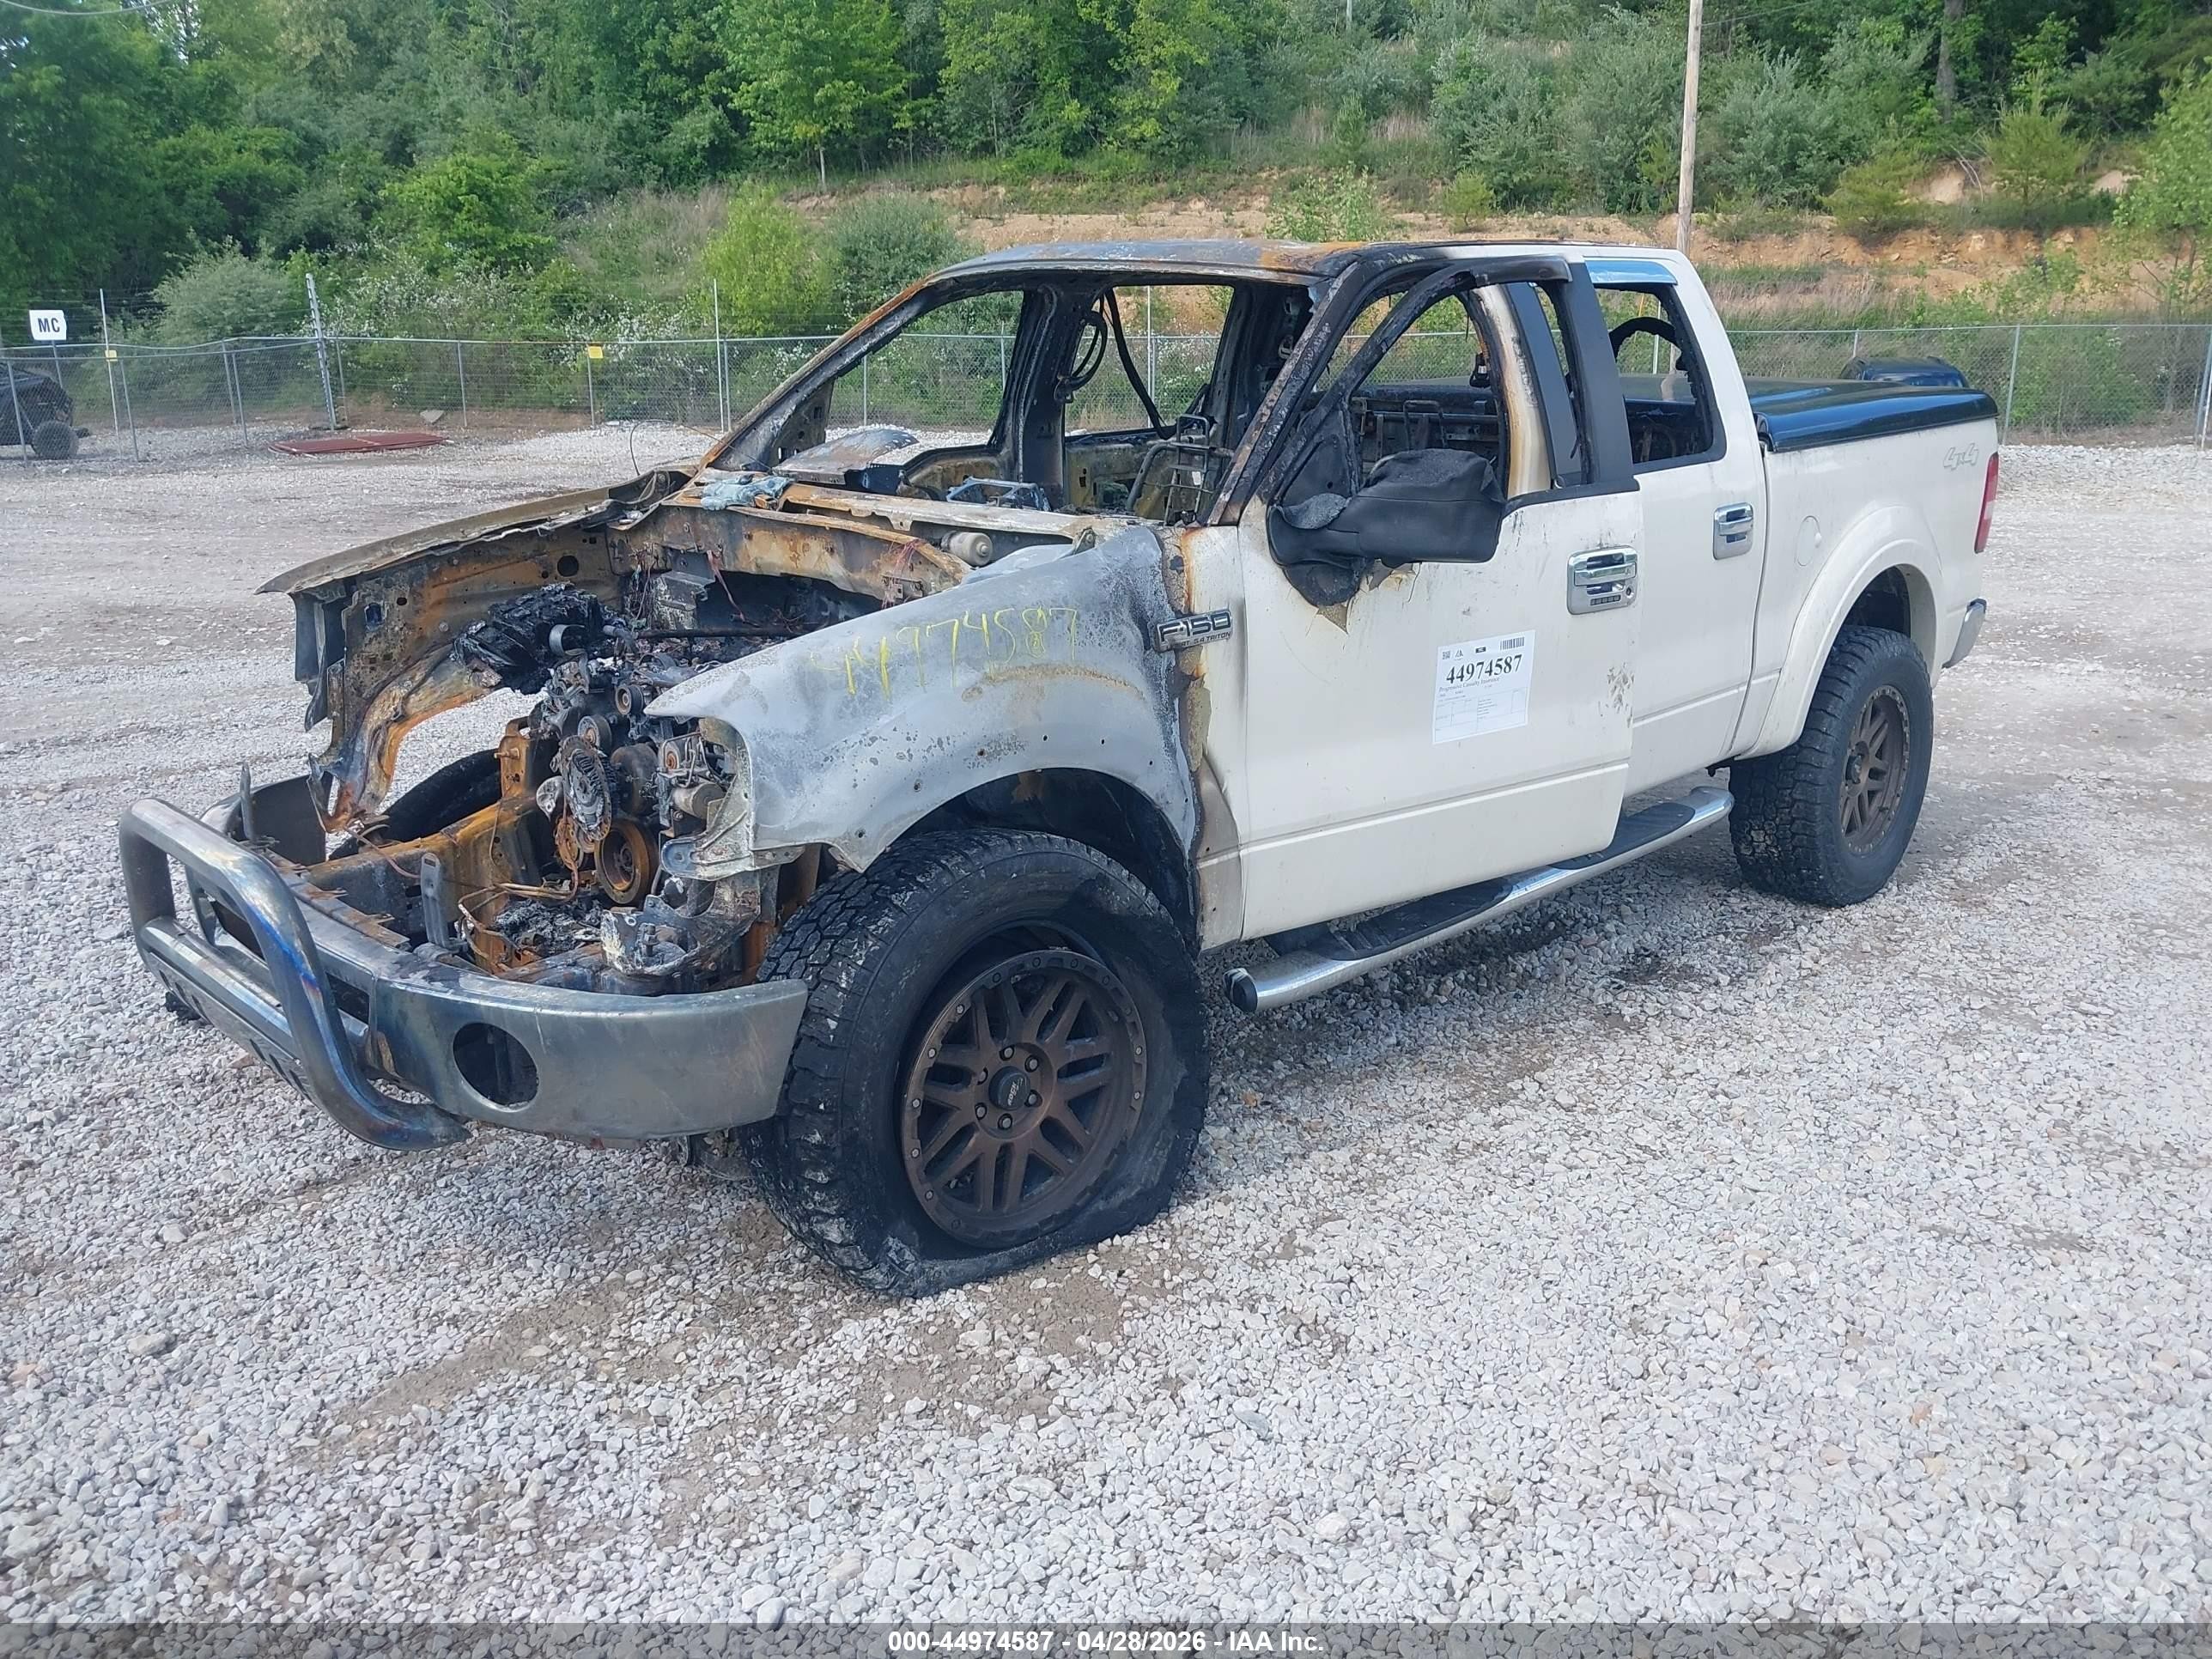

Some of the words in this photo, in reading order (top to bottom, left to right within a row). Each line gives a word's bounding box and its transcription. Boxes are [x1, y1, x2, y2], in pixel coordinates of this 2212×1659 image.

[37, 317, 60, 333] MC
[1942, 442, 1979, 471] 4x4
[1206, 631, 1231, 642] TRITON
[1445, 653, 1522, 684] 44974587
[1438, 684, 1462, 693] Progressive
